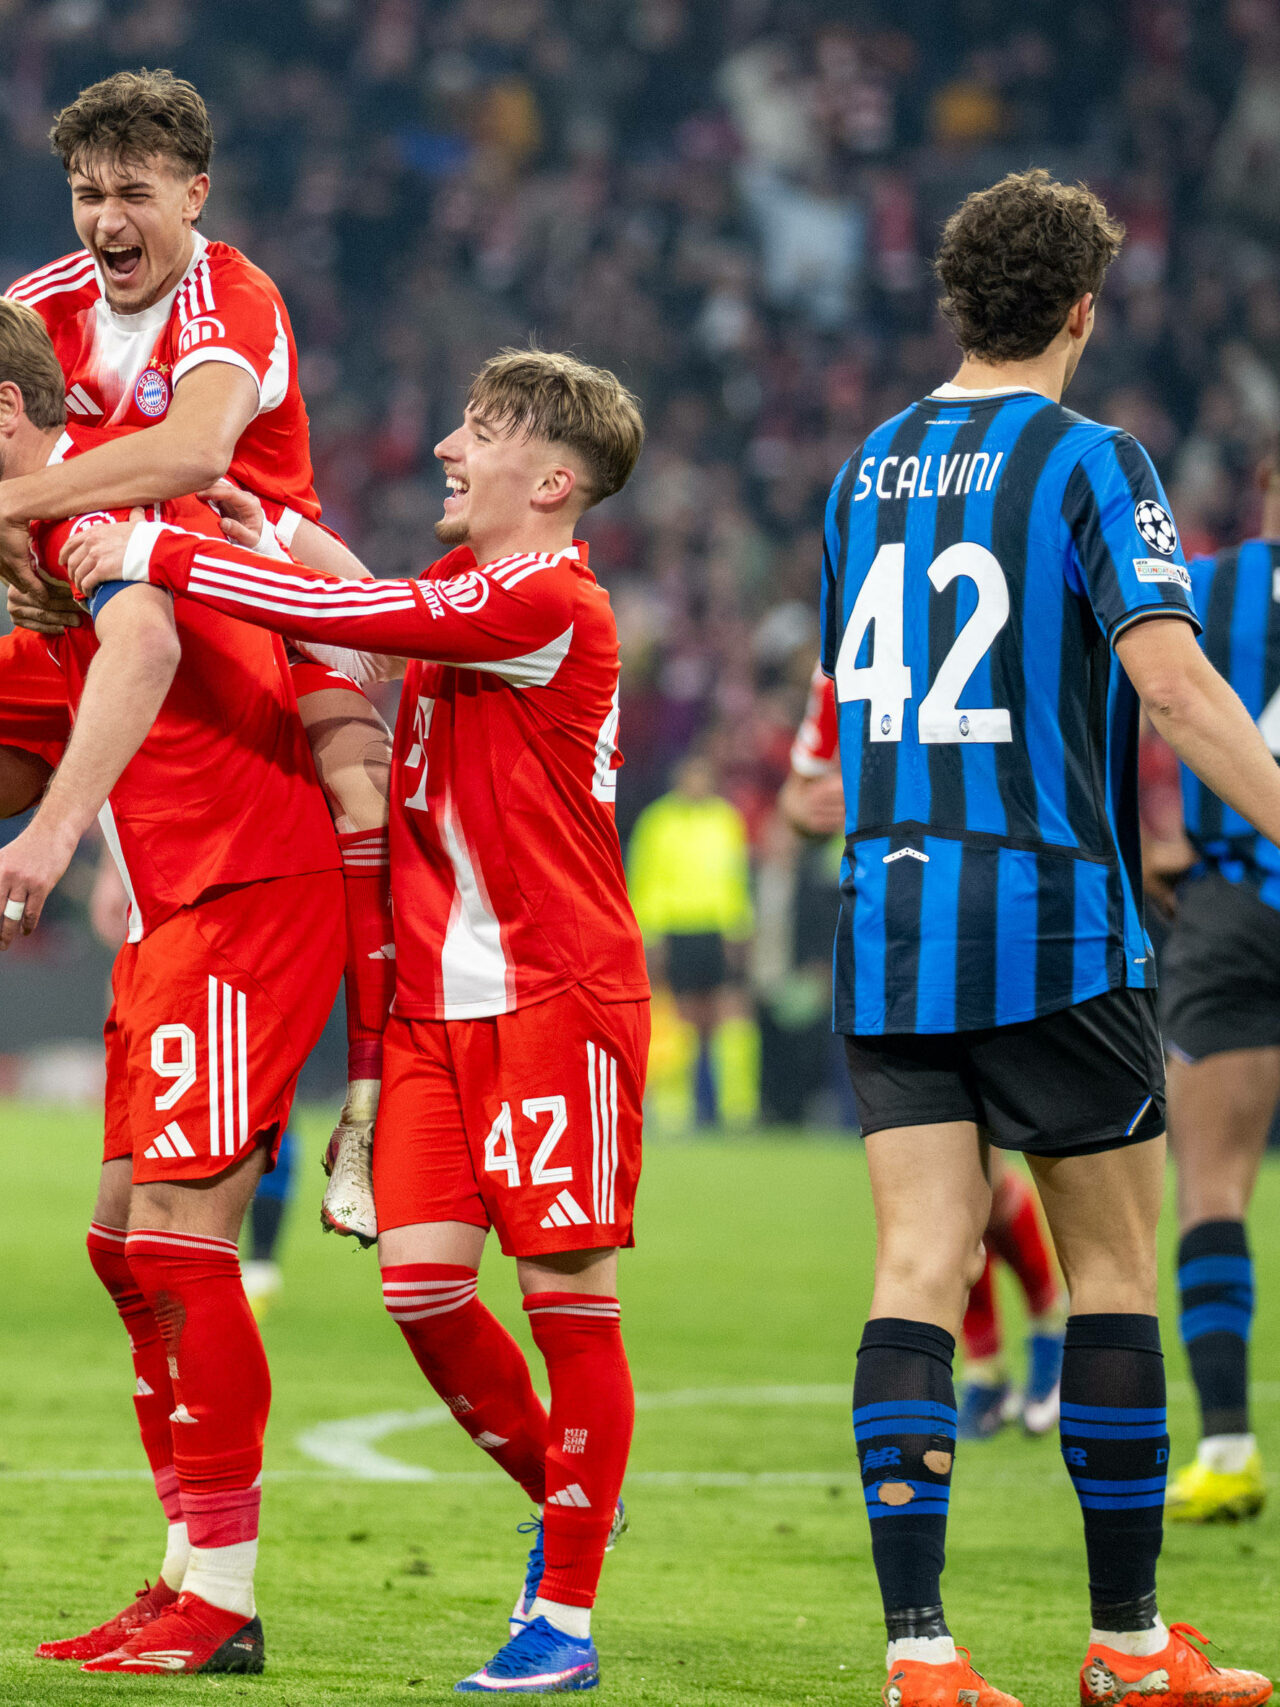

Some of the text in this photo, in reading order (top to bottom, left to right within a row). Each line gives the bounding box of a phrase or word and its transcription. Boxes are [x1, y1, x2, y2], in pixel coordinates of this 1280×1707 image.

[854, 451, 1004, 502] SCALVINI
[834, 541, 1013, 744] 42
[150, 1023, 197, 1111] 9
[484, 1094, 573, 1187] 42
[562, 1444, 585, 1454] MIA
[564, 1428, 588, 1437] MIA
[564, 1436, 586, 1446] SAN
